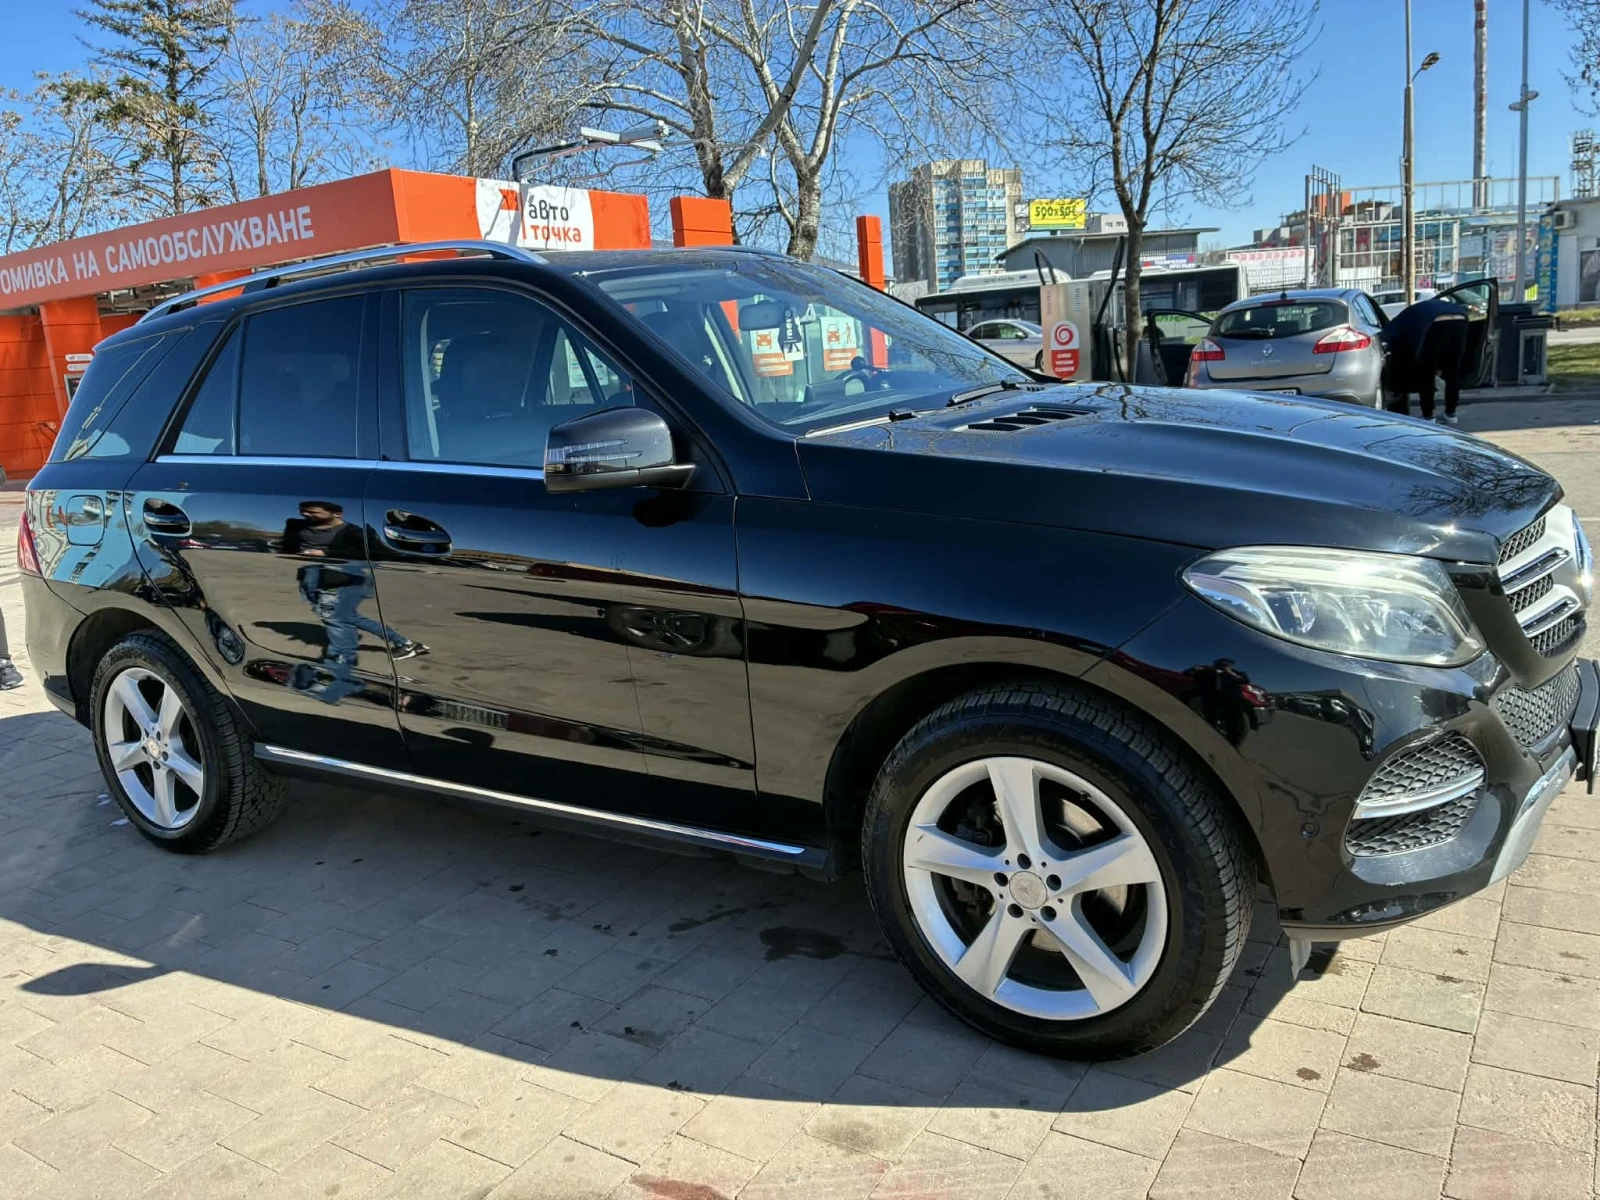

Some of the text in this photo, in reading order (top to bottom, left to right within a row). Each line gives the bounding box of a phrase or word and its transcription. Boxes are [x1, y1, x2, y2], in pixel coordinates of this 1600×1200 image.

[528, 200, 569, 221] авто
[530, 225, 581, 242] точка
[0, 205, 314, 294] ОМИВКА НА САМООБСЛУЖВАНЕ
